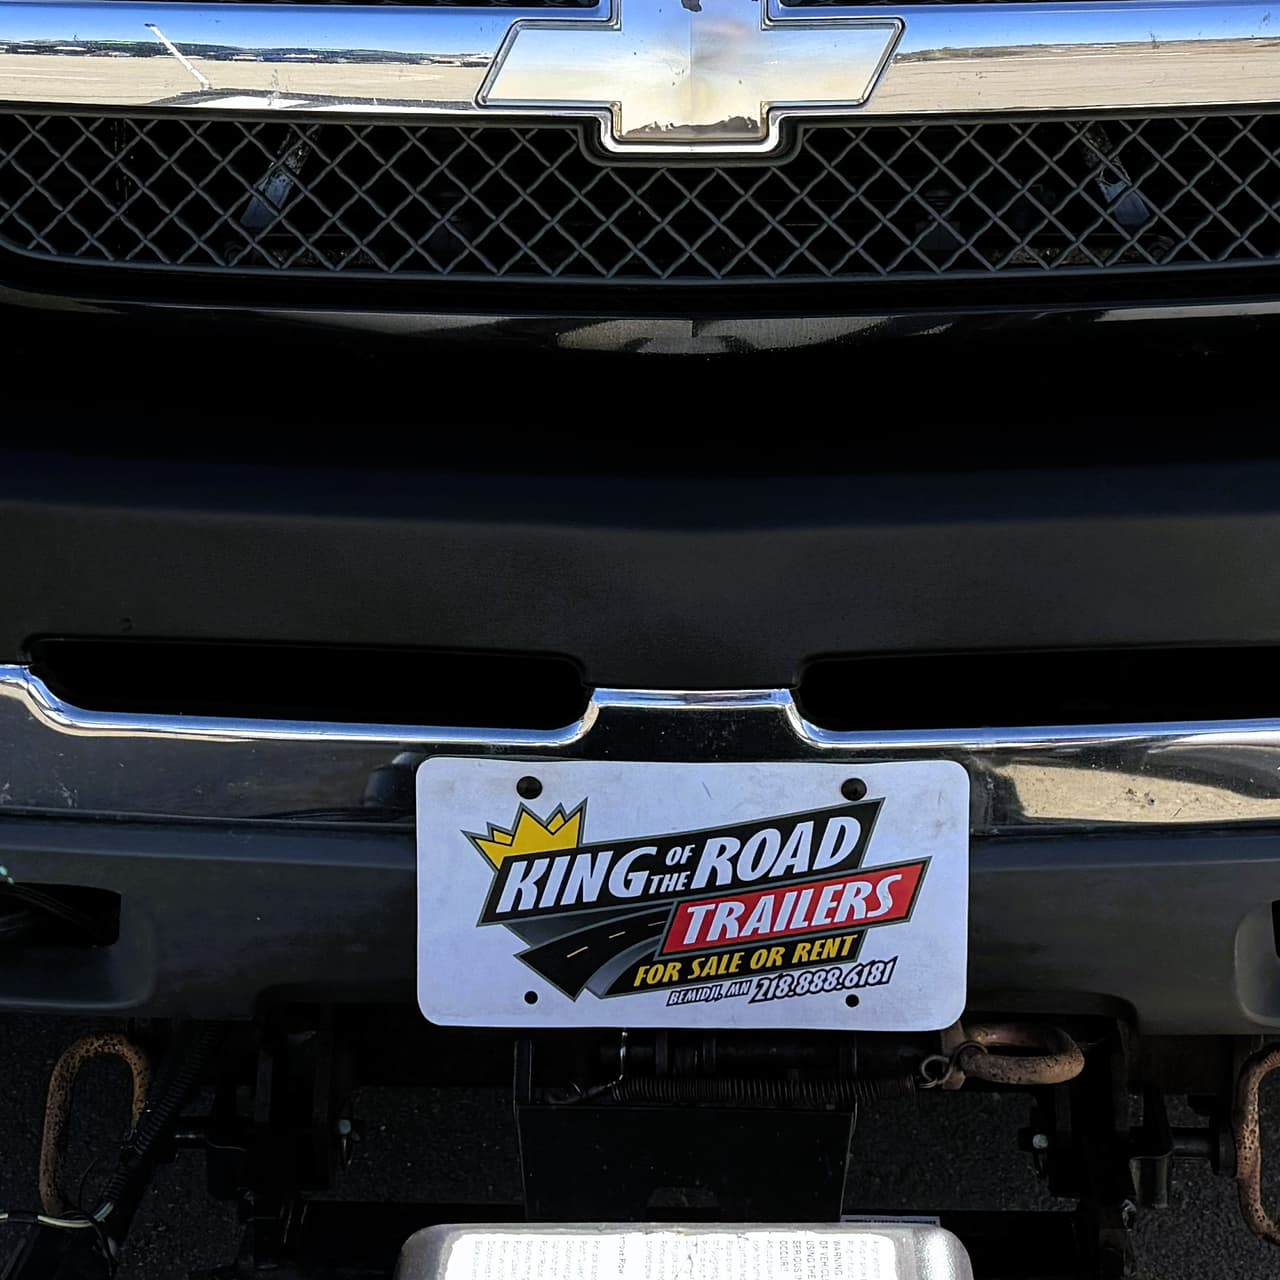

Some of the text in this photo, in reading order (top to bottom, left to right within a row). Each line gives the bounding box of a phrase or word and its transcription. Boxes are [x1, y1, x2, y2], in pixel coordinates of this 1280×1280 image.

[495, 816, 861, 914] KING OF THE ROAD
[683, 874, 902, 945] TRAILERS
[633, 934, 858, 987] FOR SALE OR RENT
[668, 958, 897, 1006] BEMIDJI, MN 218.888.6181
